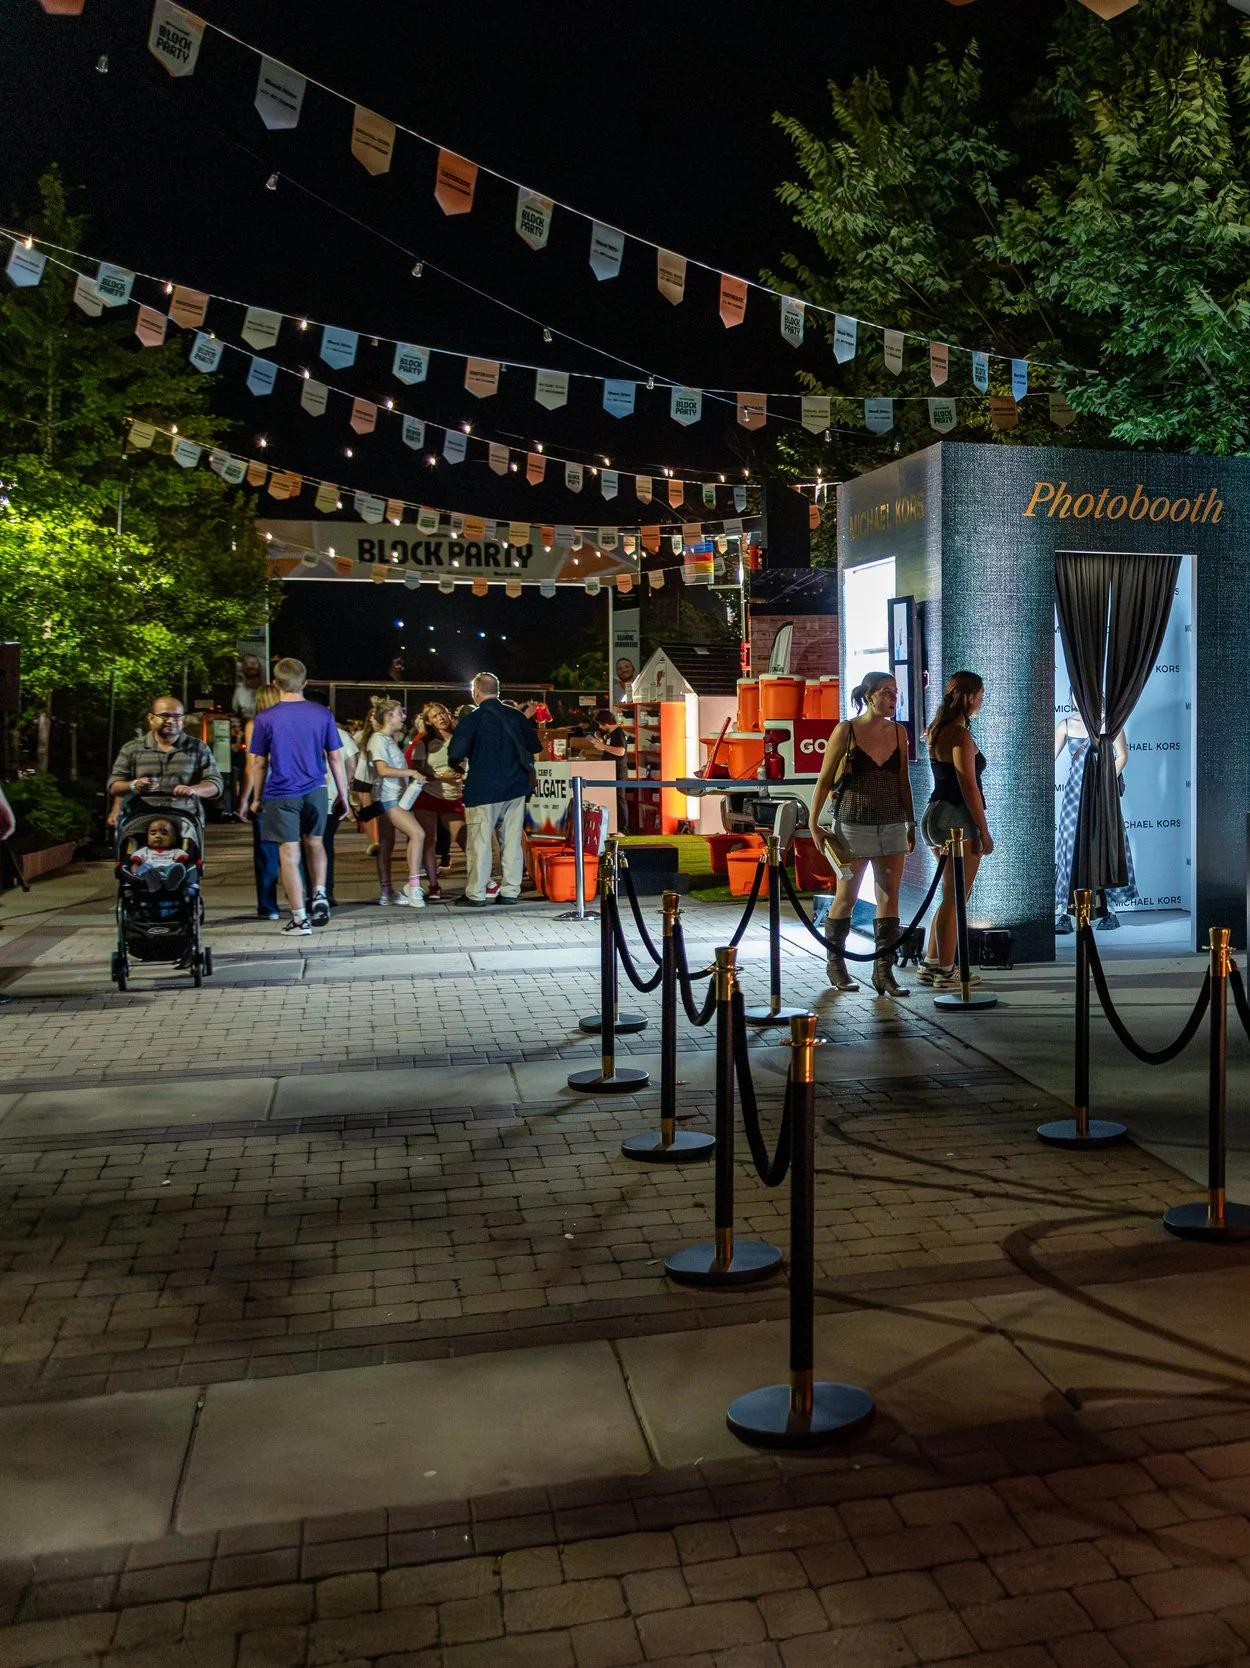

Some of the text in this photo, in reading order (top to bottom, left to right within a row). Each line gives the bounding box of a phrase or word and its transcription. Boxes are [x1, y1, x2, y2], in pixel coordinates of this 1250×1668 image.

[156, 38, 190, 64] PARTY
[522, 209, 545, 228] BLOCK
[521, 219, 543, 238] PARTY
[784, 314, 801, 329] BLOCK
[784, 324, 800, 337] PARTY
[675, 407, 697, 416] PARTY
[676, 400, 697, 410] BLOCK
[1022, 481, 1224, 525] Photobooth
[849, 491, 925, 543] MICHAEL KORS
[357, 539, 533, 569] BLOCK PARTY
[1129, 742, 1180, 751] HAEL KORS
[1124, 819, 1181, 829] CHAEL KORS
[1157, 896, 1182, 905] KORS
